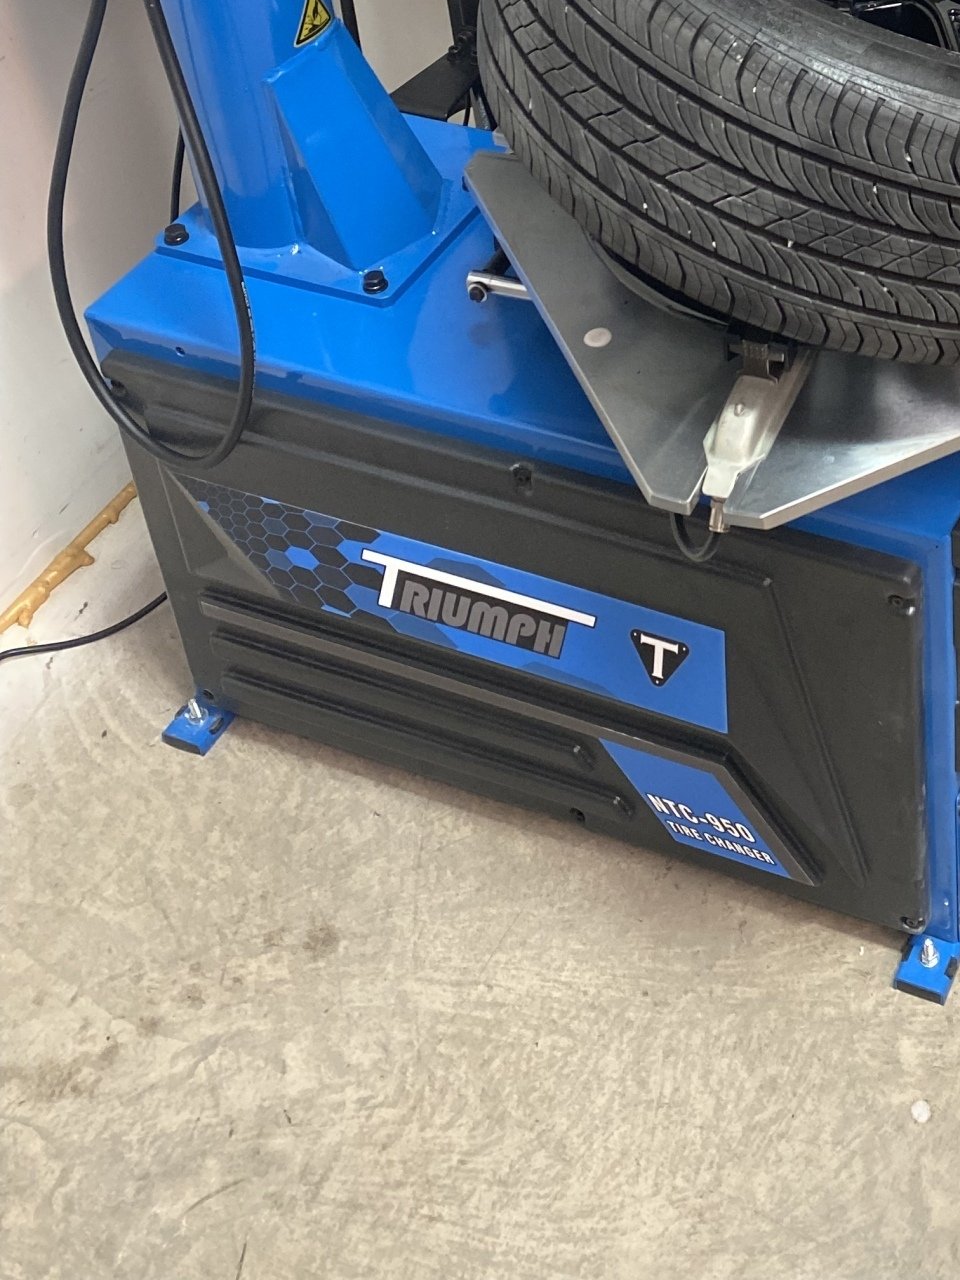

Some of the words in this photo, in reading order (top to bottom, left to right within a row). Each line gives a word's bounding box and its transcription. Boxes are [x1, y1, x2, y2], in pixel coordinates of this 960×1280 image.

[361, 548, 596, 659] TRIUMPH
[640, 633, 679, 679] T
[647, 793, 756, 844] NTC-950
[667, 820, 703, 841] TIRE
[704, 833, 776, 866] CHANGER
